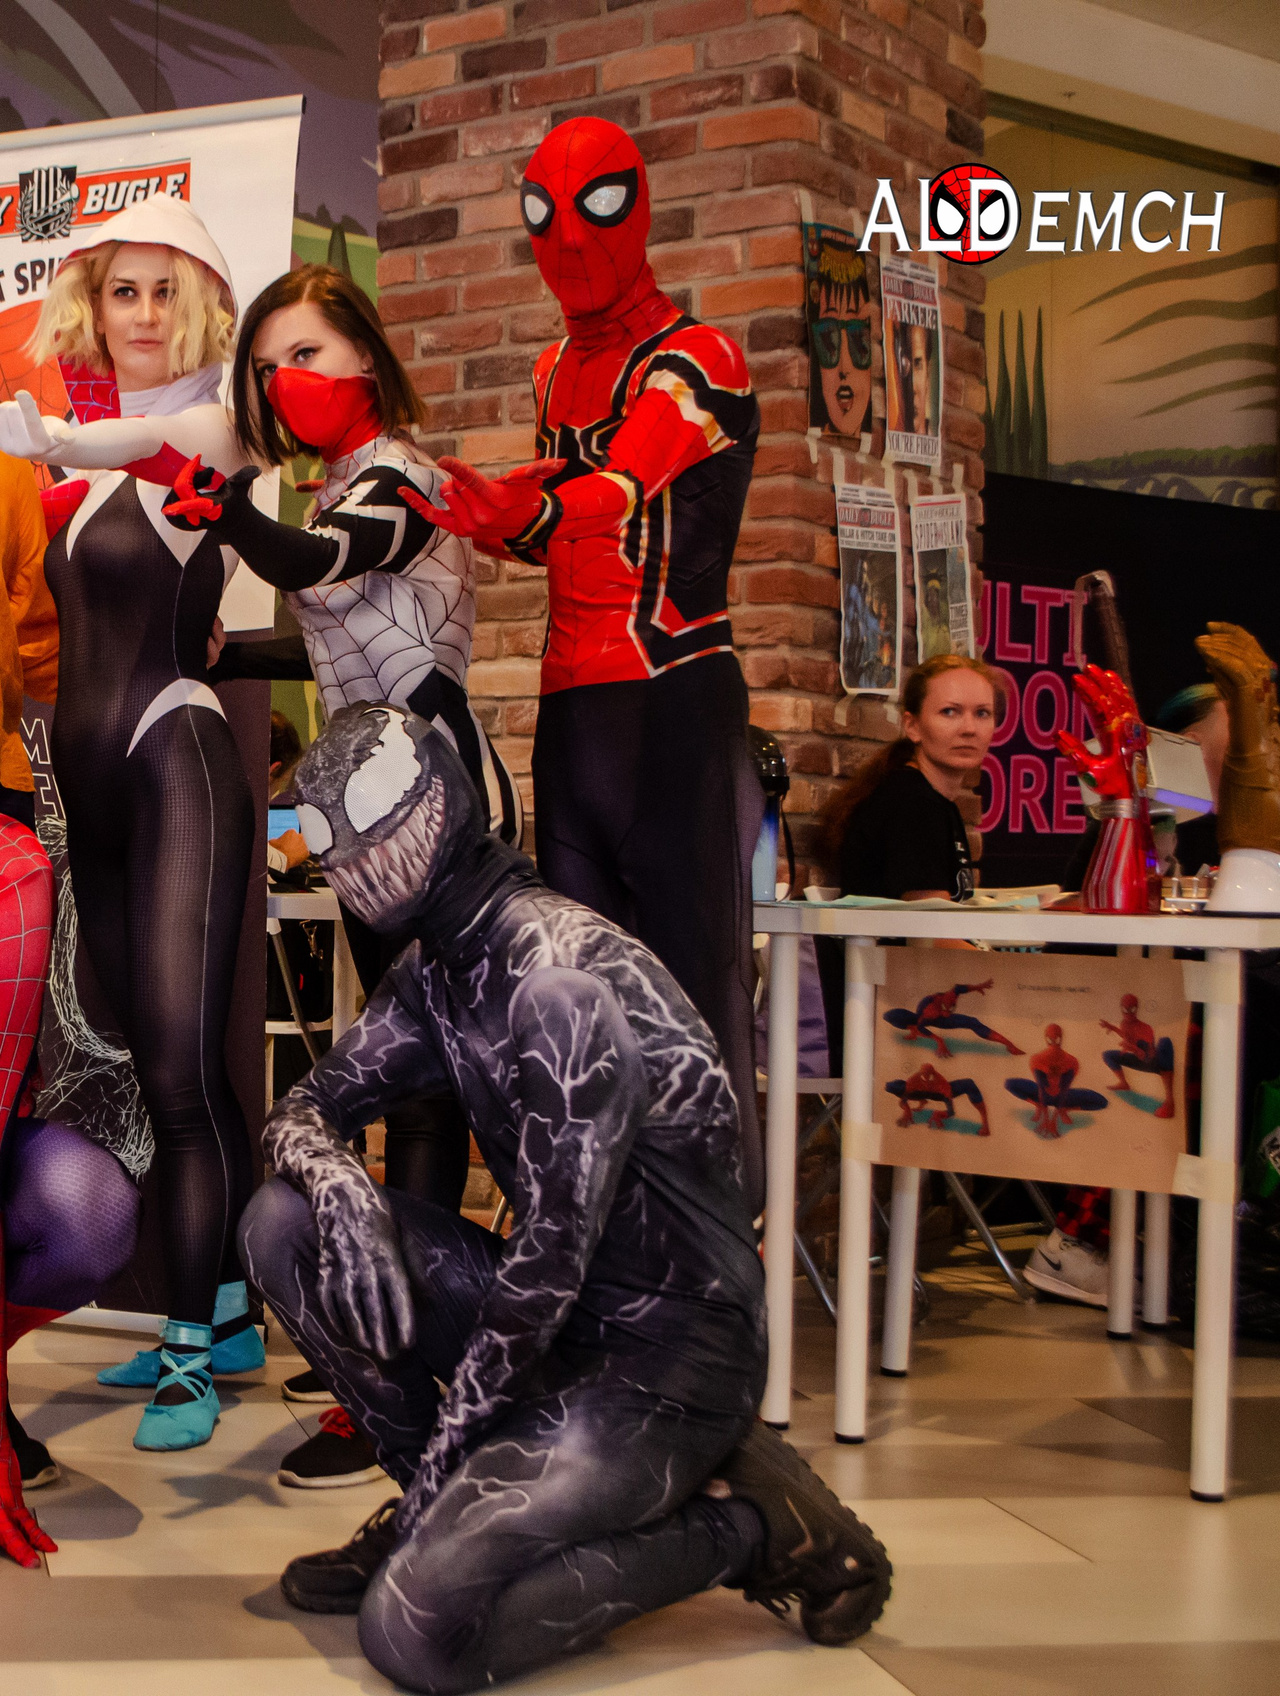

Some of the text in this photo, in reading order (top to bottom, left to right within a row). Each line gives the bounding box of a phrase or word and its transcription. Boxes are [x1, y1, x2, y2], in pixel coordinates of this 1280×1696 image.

[14, 257, 64, 295] SPI
[839, 507, 893, 527] DAILY BUGLE
